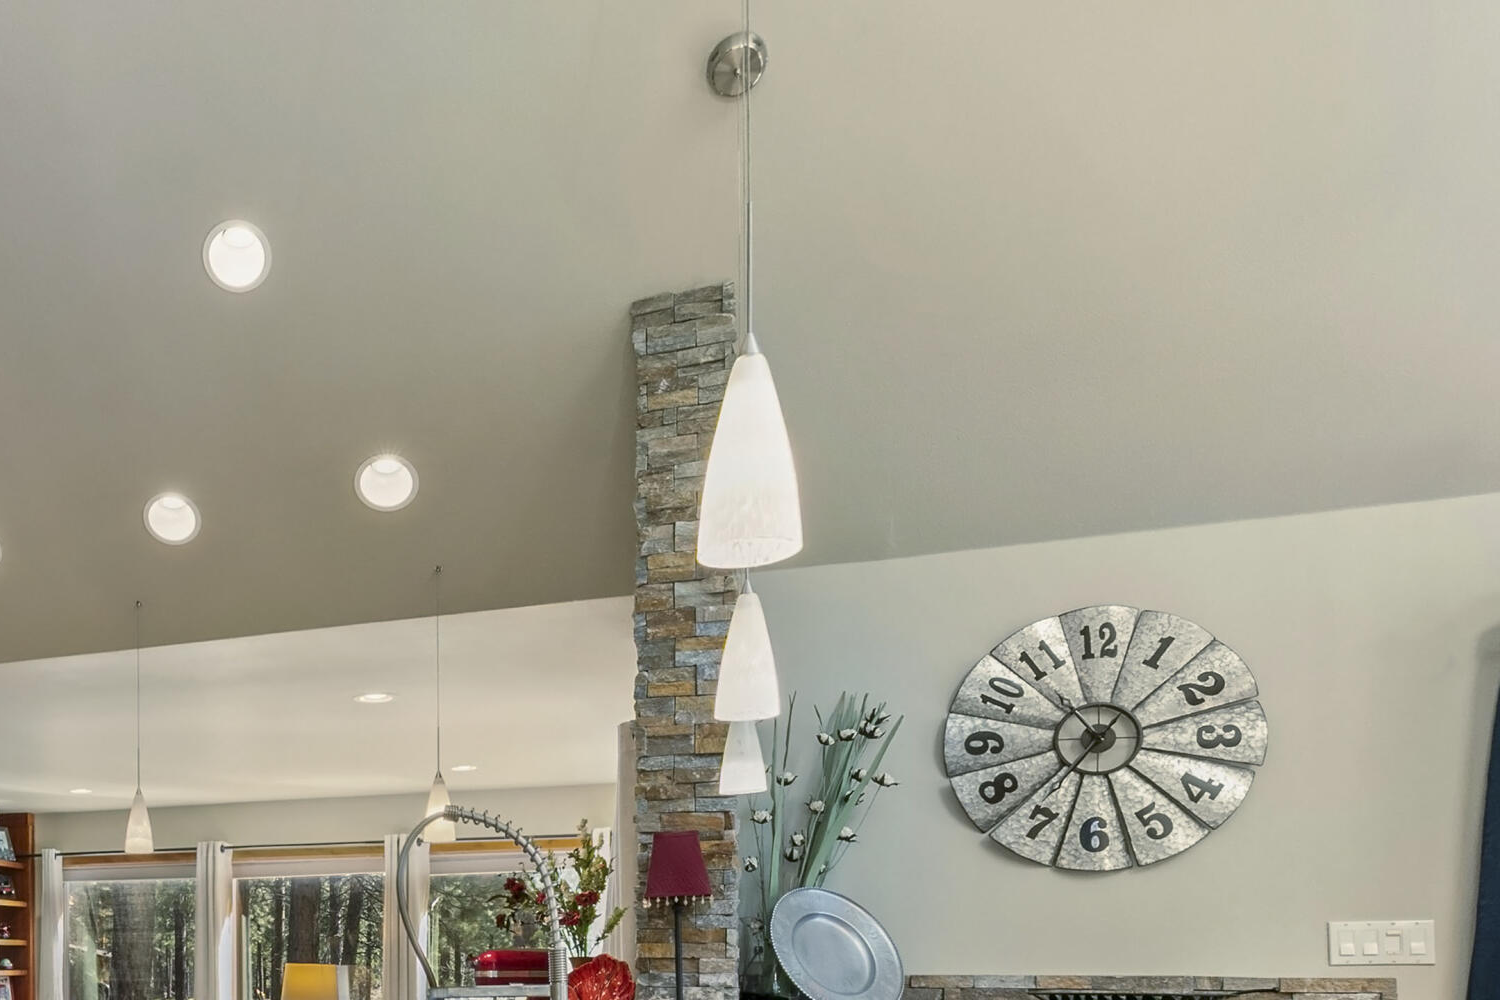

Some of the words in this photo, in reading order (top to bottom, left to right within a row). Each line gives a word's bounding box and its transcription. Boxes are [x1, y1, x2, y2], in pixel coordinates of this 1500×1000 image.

[1079, 621, 1118, 660] 12
[1142, 634, 1176, 670] 1
[1018, 639, 1067, 681] 11
[979, 677, 1026, 715] 10
[1176, 670, 1226, 706] 2
[964, 730, 1005, 756] 9
[1196, 724, 1243, 749] 3
[977, 771, 1019, 805] 8
[1180, 771, 1225, 804] 4
[1025, 804, 1060, 840] 7
[1079, 816, 1110, 853] 6
[1134, 801, 1174, 840] 5
